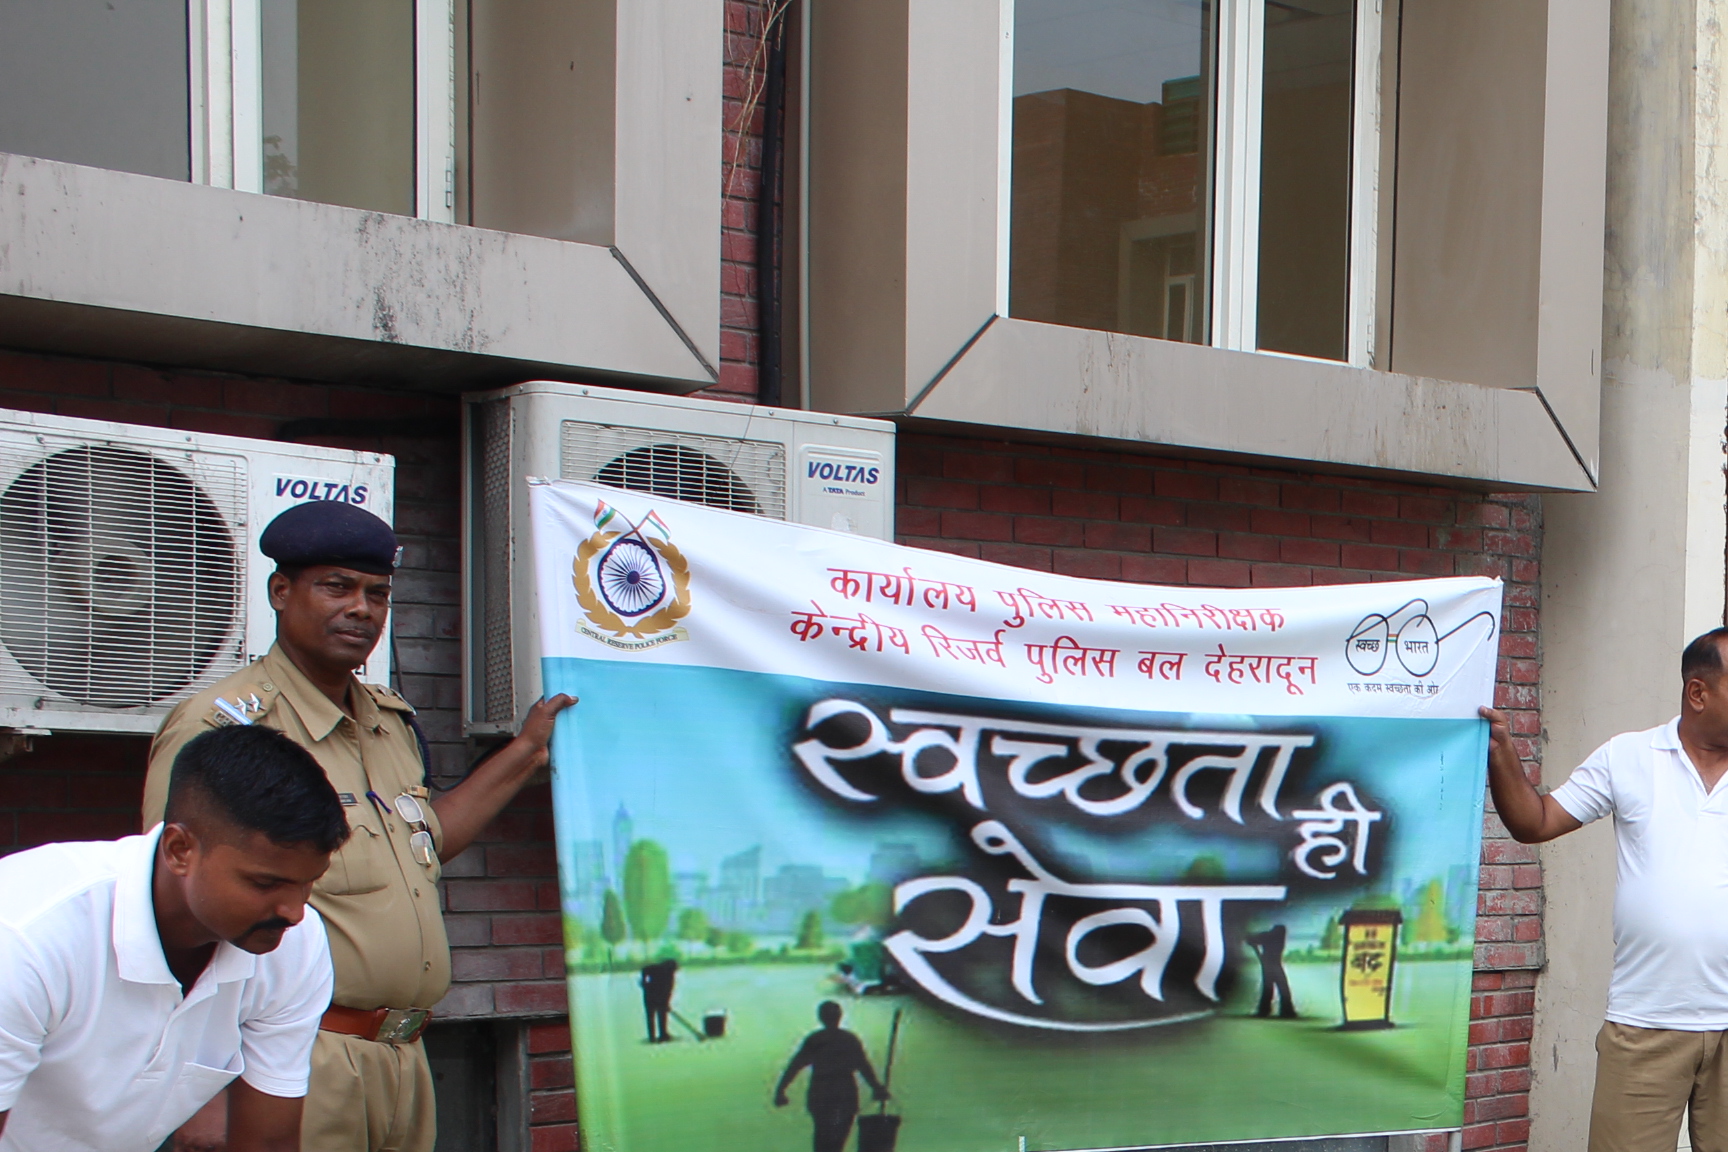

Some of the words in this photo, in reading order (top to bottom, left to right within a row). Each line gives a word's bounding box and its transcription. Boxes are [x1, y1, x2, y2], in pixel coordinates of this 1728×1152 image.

[275, 477, 369, 504] VOLTAS
[808, 461, 880, 485] VOLTAS
[826, 567, 976, 612] कार्यालय
[993, 587, 1094, 628] पुलिस
[1104, 603, 1285, 632] महानिरीक्षक
[580, 626, 607, 642] CENTRAL
[607, 638, 634, 650] RESERVE
[634, 640, 656, 650] POLICE
[656, 634, 678, 646] FORCE
[790, 600, 910, 655] केन्द्रीय
[920, 624, 1007, 668] रिजर्व
[1024, 635, 1121, 684] पुलिस
[1137, 651, 1188, 680] बल
[1204, 643, 1318, 695] देहरादून
[1355, 639, 1381, 653] स्वच्छ
[1404, 640, 1429, 653] भारत
[1347, 683, 1361, 695] एक
[1364, 683, 1382, 693] कदम
[1385, 683, 1411, 694] स्वच्छता
[1414, 680, 1424, 694] की
[793, 698, 1315, 825] स्वच्छता
[1291, 781, 1381, 880] ही
[884, 818, 1288, 1031] सेवा
